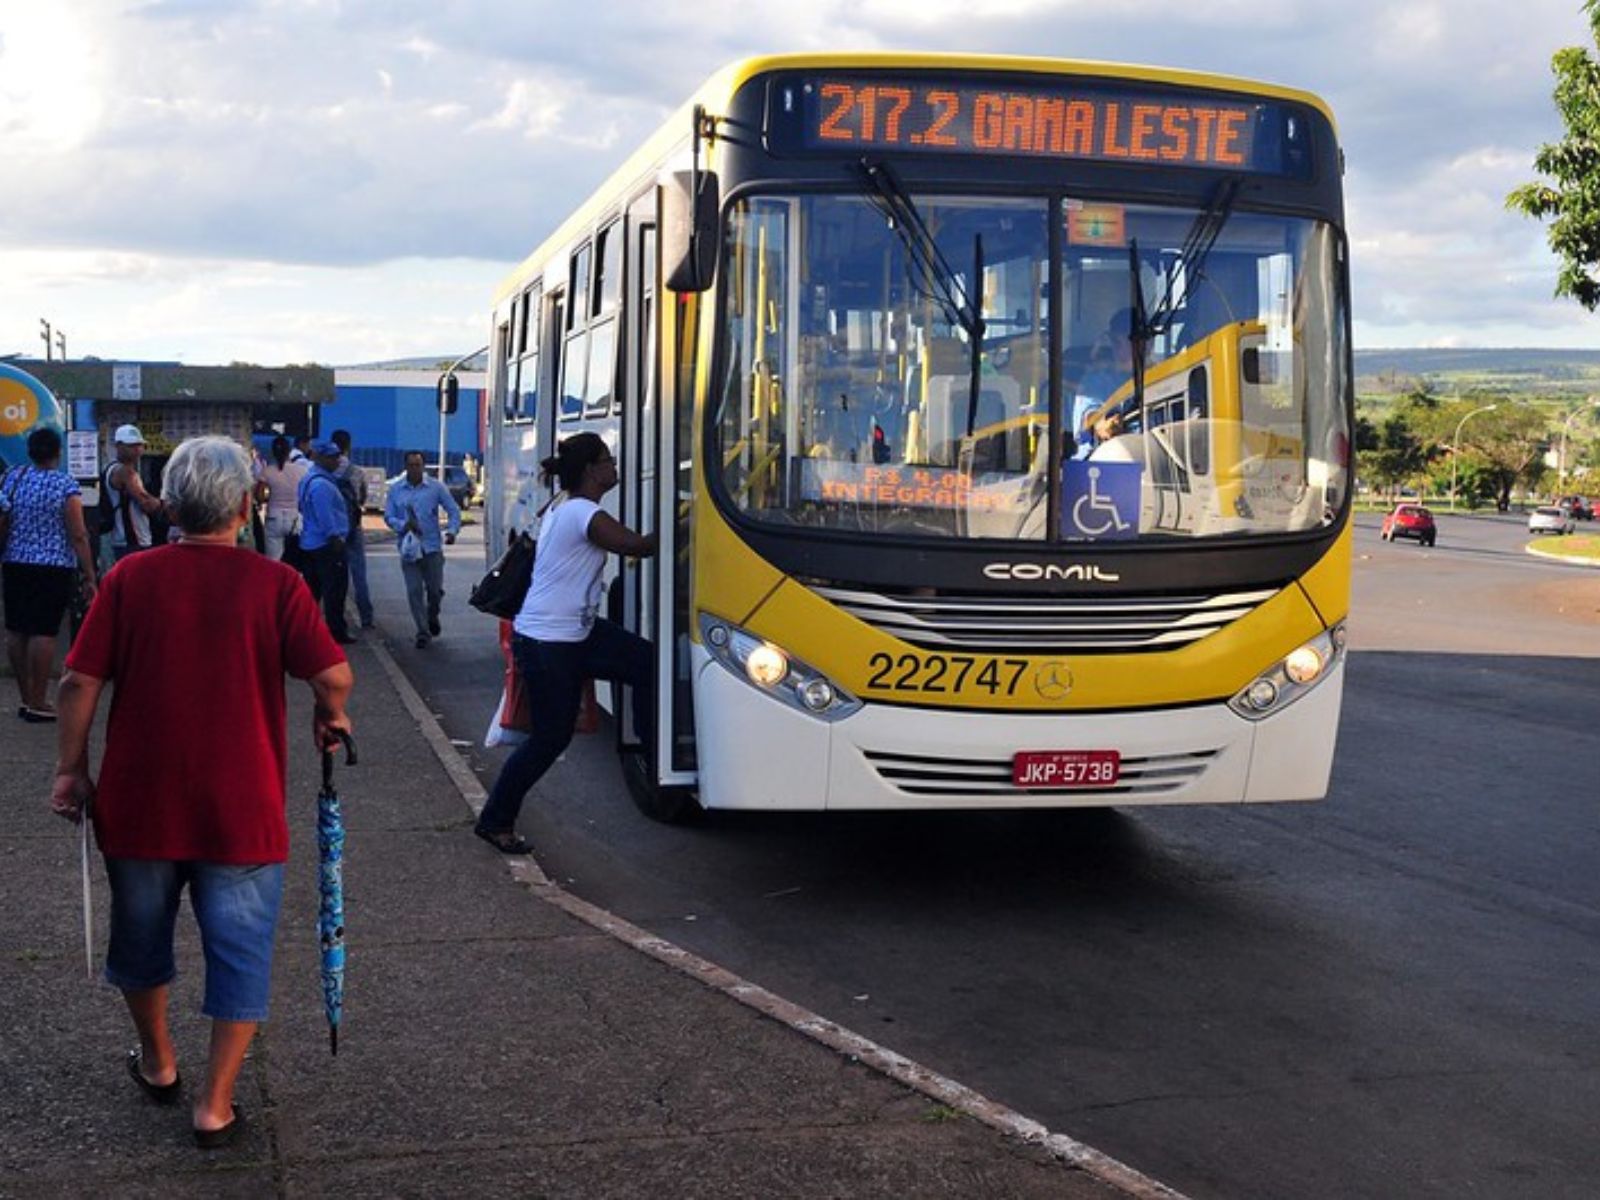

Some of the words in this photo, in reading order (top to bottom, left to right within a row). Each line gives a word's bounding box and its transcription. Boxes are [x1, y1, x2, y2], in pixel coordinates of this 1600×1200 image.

[819, 83, 959, 146] 217.2
[973, 93, 1096, 154] GAMA
[1103, 103, 1247, 165] LESTE
[4, 399, 27, 420] oi
[982, 562, 1120, 582] COMIL
[867, 652, 1029, 696] 222747
[1018, 761, 1114, 783] JKP-5738
